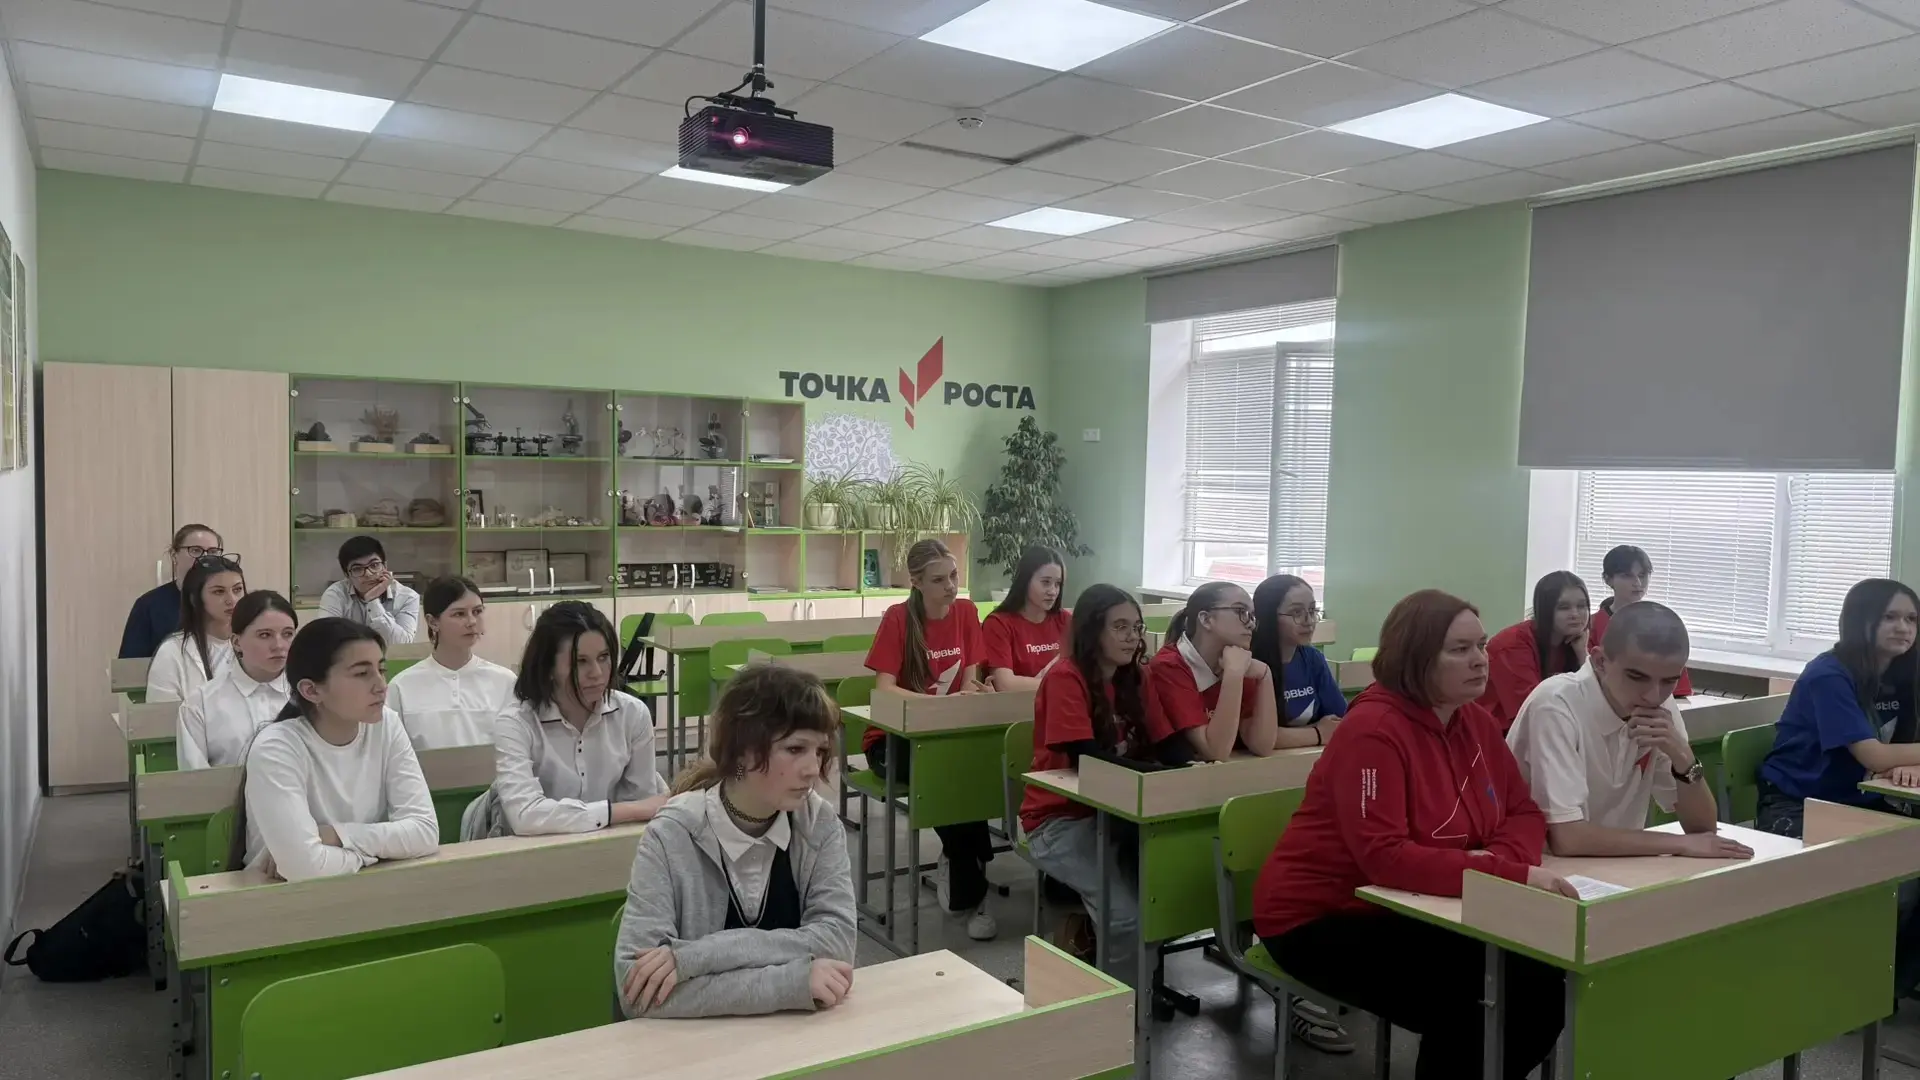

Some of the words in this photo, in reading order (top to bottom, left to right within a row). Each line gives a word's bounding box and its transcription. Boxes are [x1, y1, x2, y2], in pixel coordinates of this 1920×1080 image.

[779, 370, 891, 403] ТОЧКА
[944, 381, 1036, 410] РОСТА
[1026, 642, 1060, 655] Первые
[1284, 686, 1316, 702] рвые
